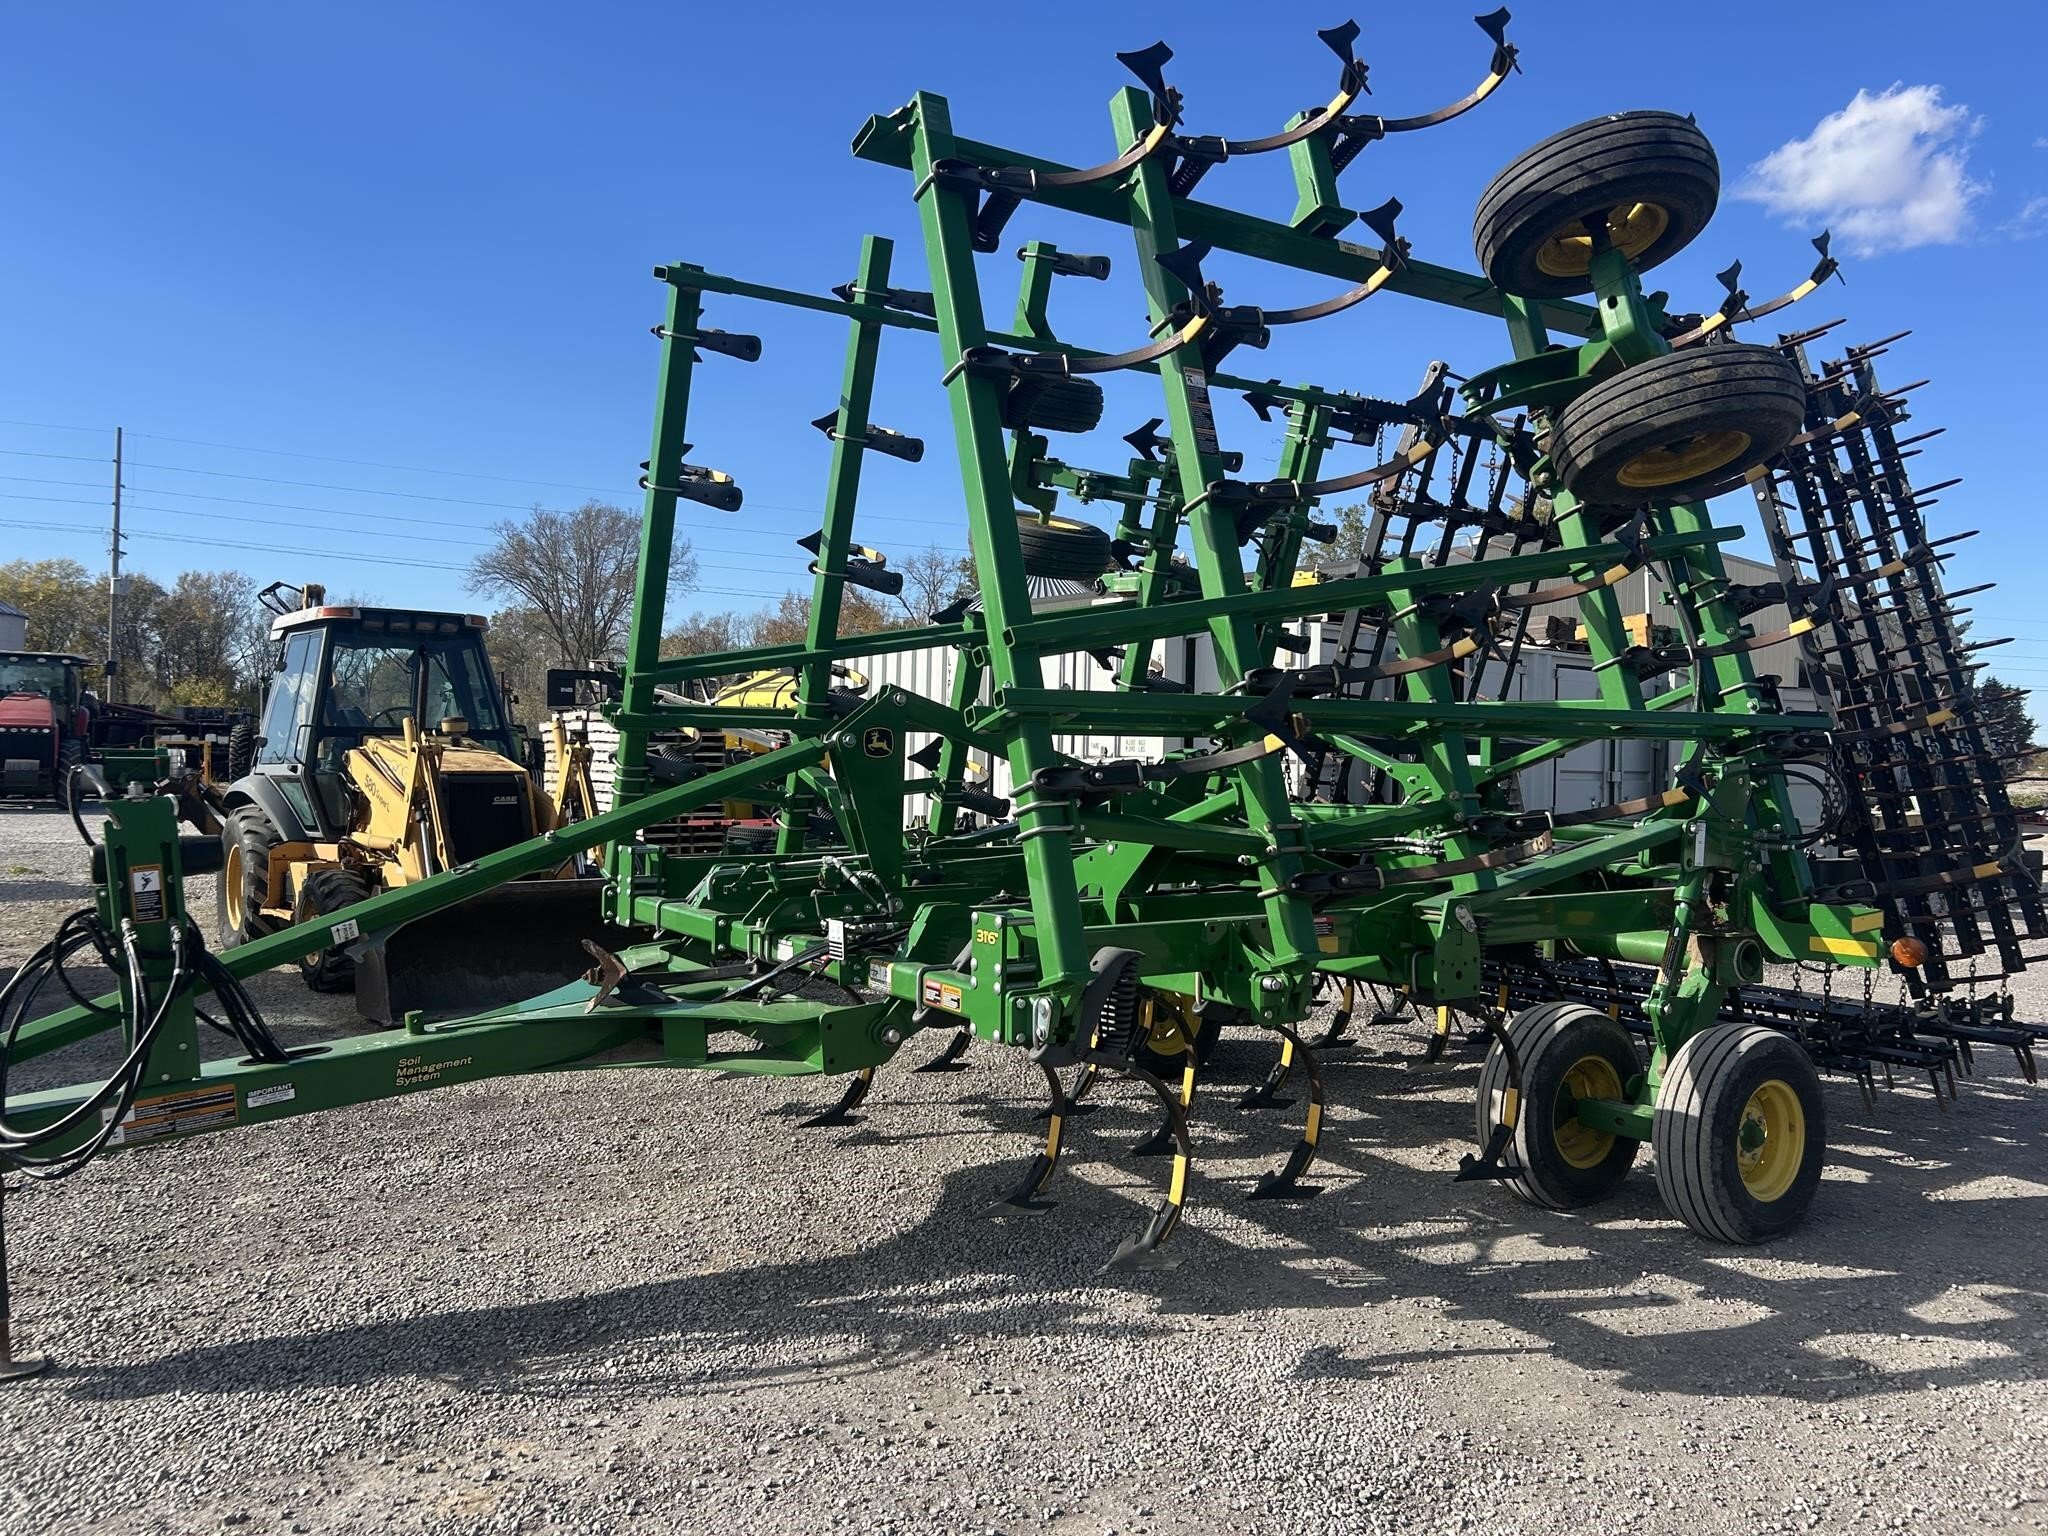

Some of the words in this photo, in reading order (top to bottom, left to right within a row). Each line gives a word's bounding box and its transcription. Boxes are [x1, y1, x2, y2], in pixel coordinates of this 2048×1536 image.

[493, 795, 518, 803] CASE
[396, 1056, 473, 1077] Management
[399, 1055, 421, 1067] Soil
[395, 1071, 441, 1087] System
[247, 1083, 294, 1098] IMPORTANT
